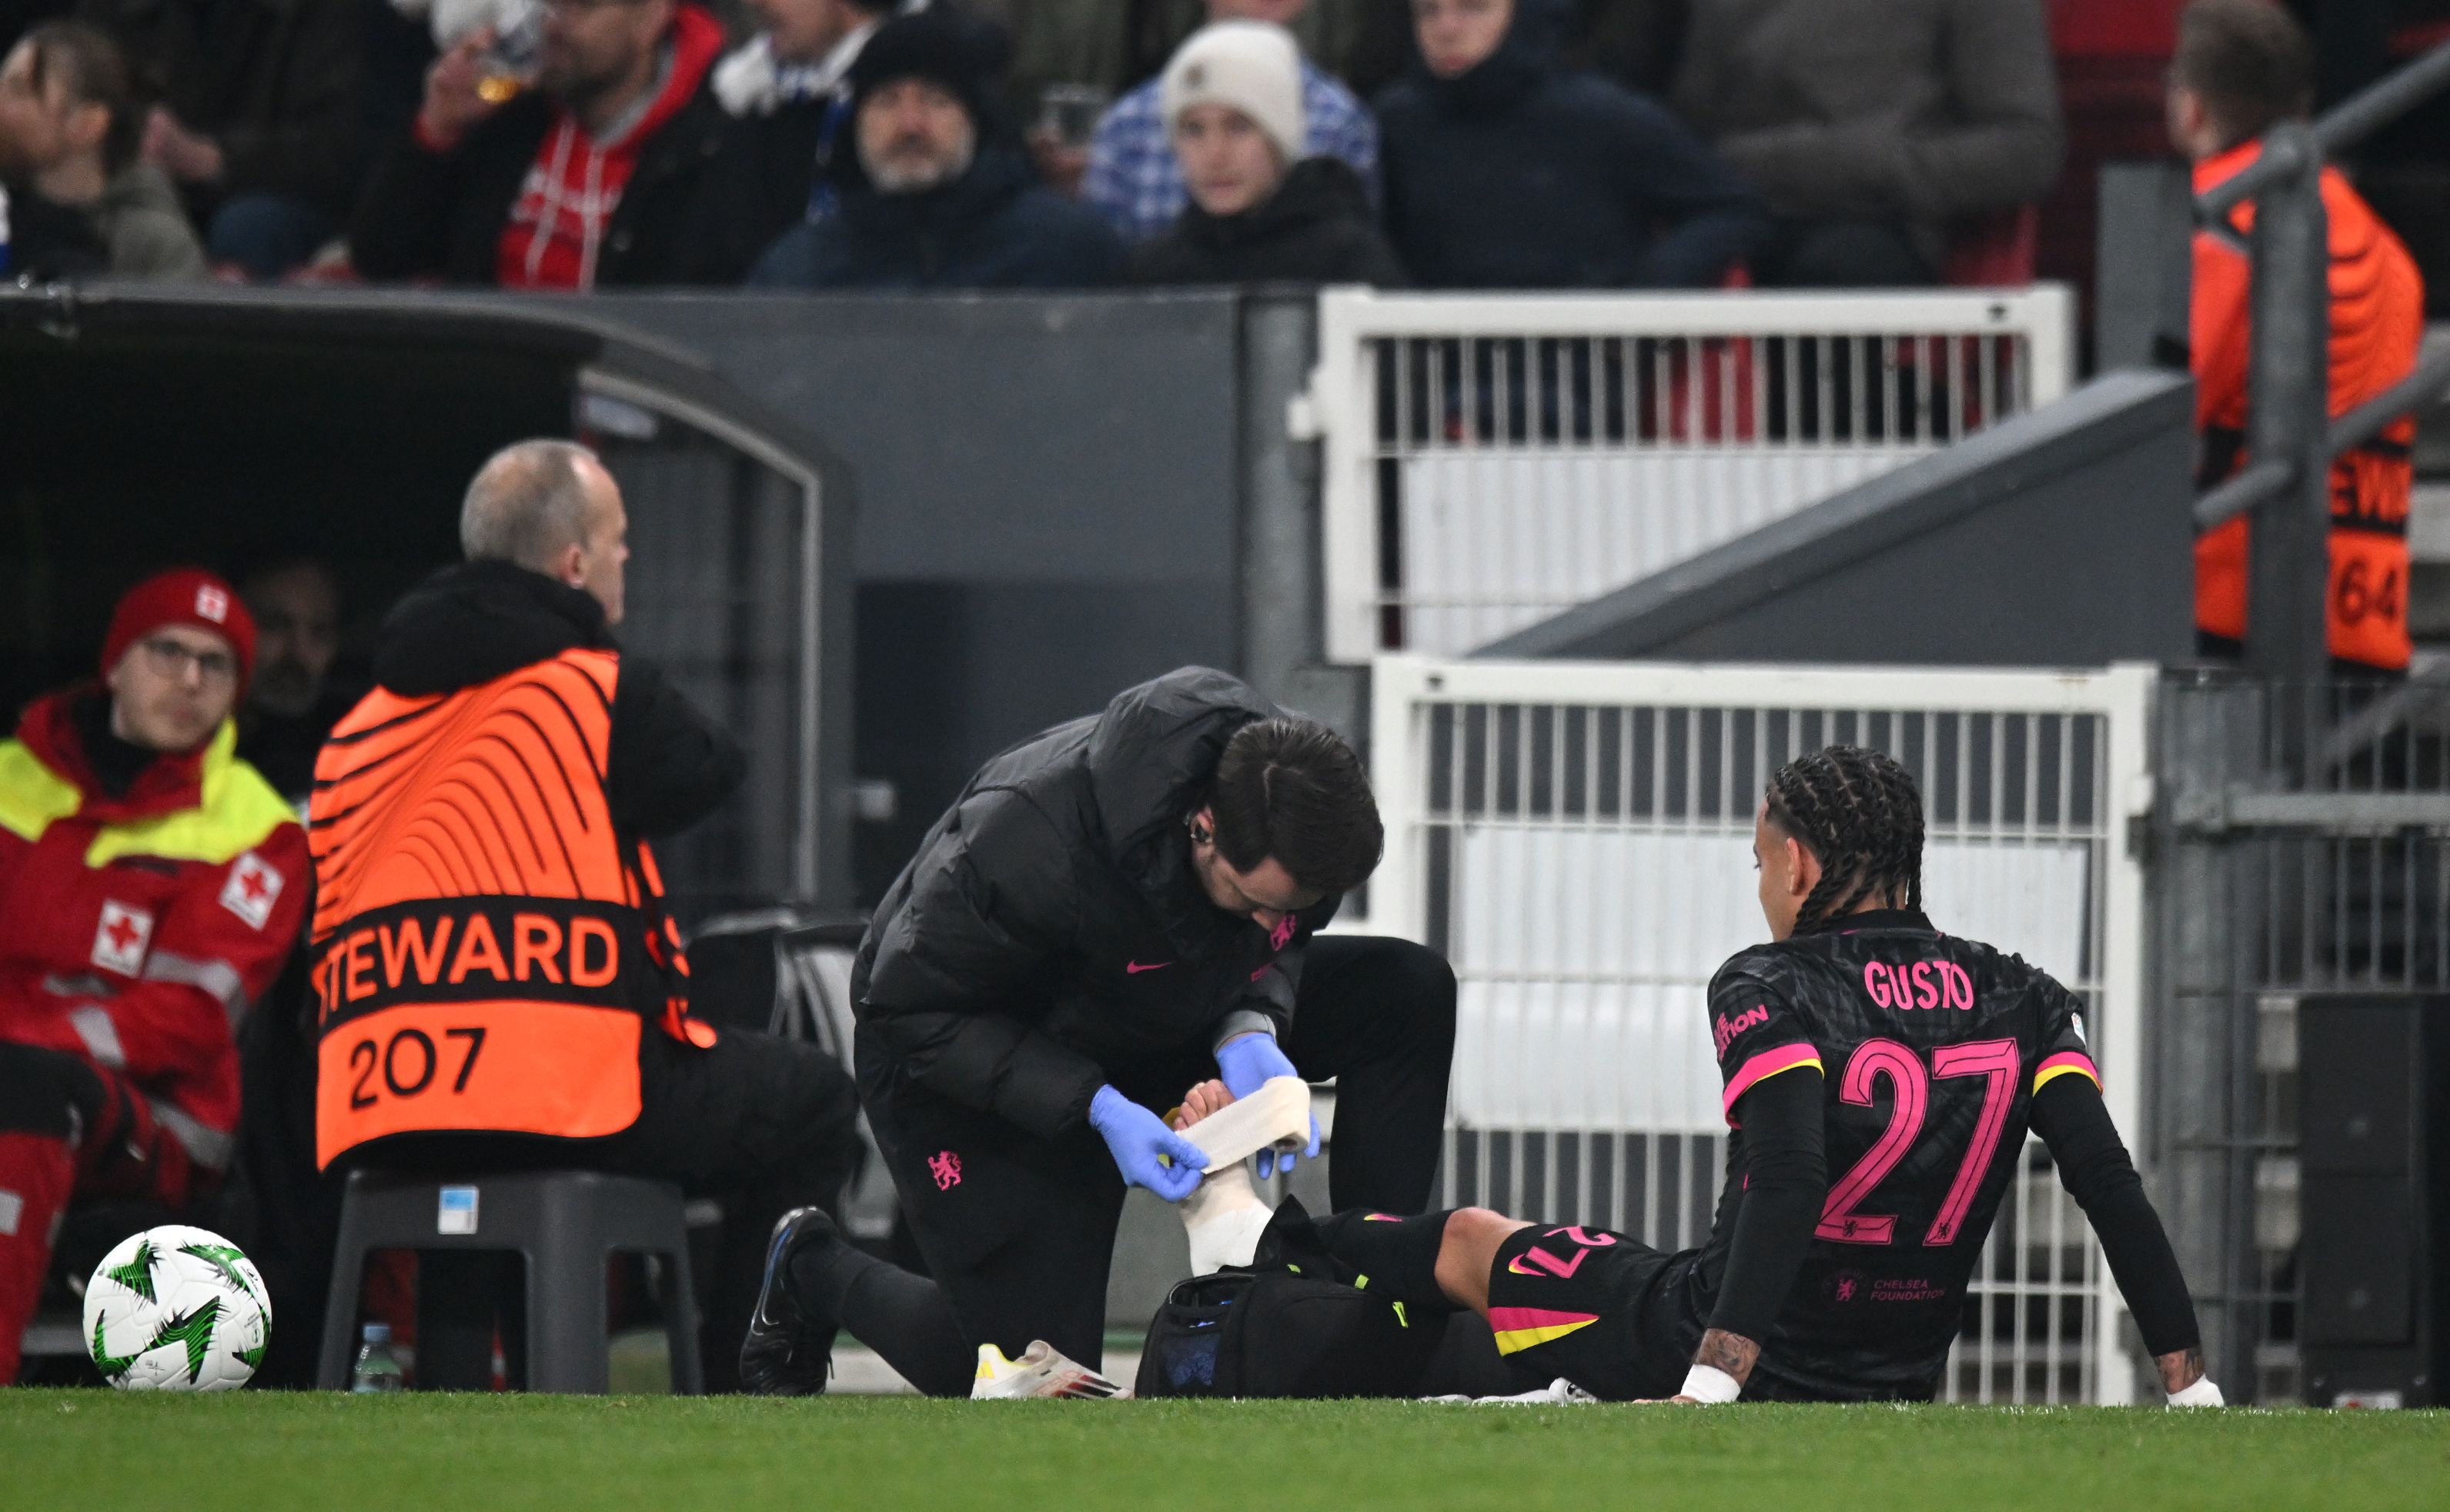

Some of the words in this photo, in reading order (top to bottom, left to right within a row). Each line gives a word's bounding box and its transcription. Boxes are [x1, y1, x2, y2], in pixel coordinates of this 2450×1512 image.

[1863, 960, 1974, 1010] GUSTO
[348, 1027, 488, 1111] 207
[1813, 1036, 2020, 1247] 27
[1869, 1287, 1947, 1302] FOUNDATION
[1873, 1278, 1929, 1290] CHELSEA
